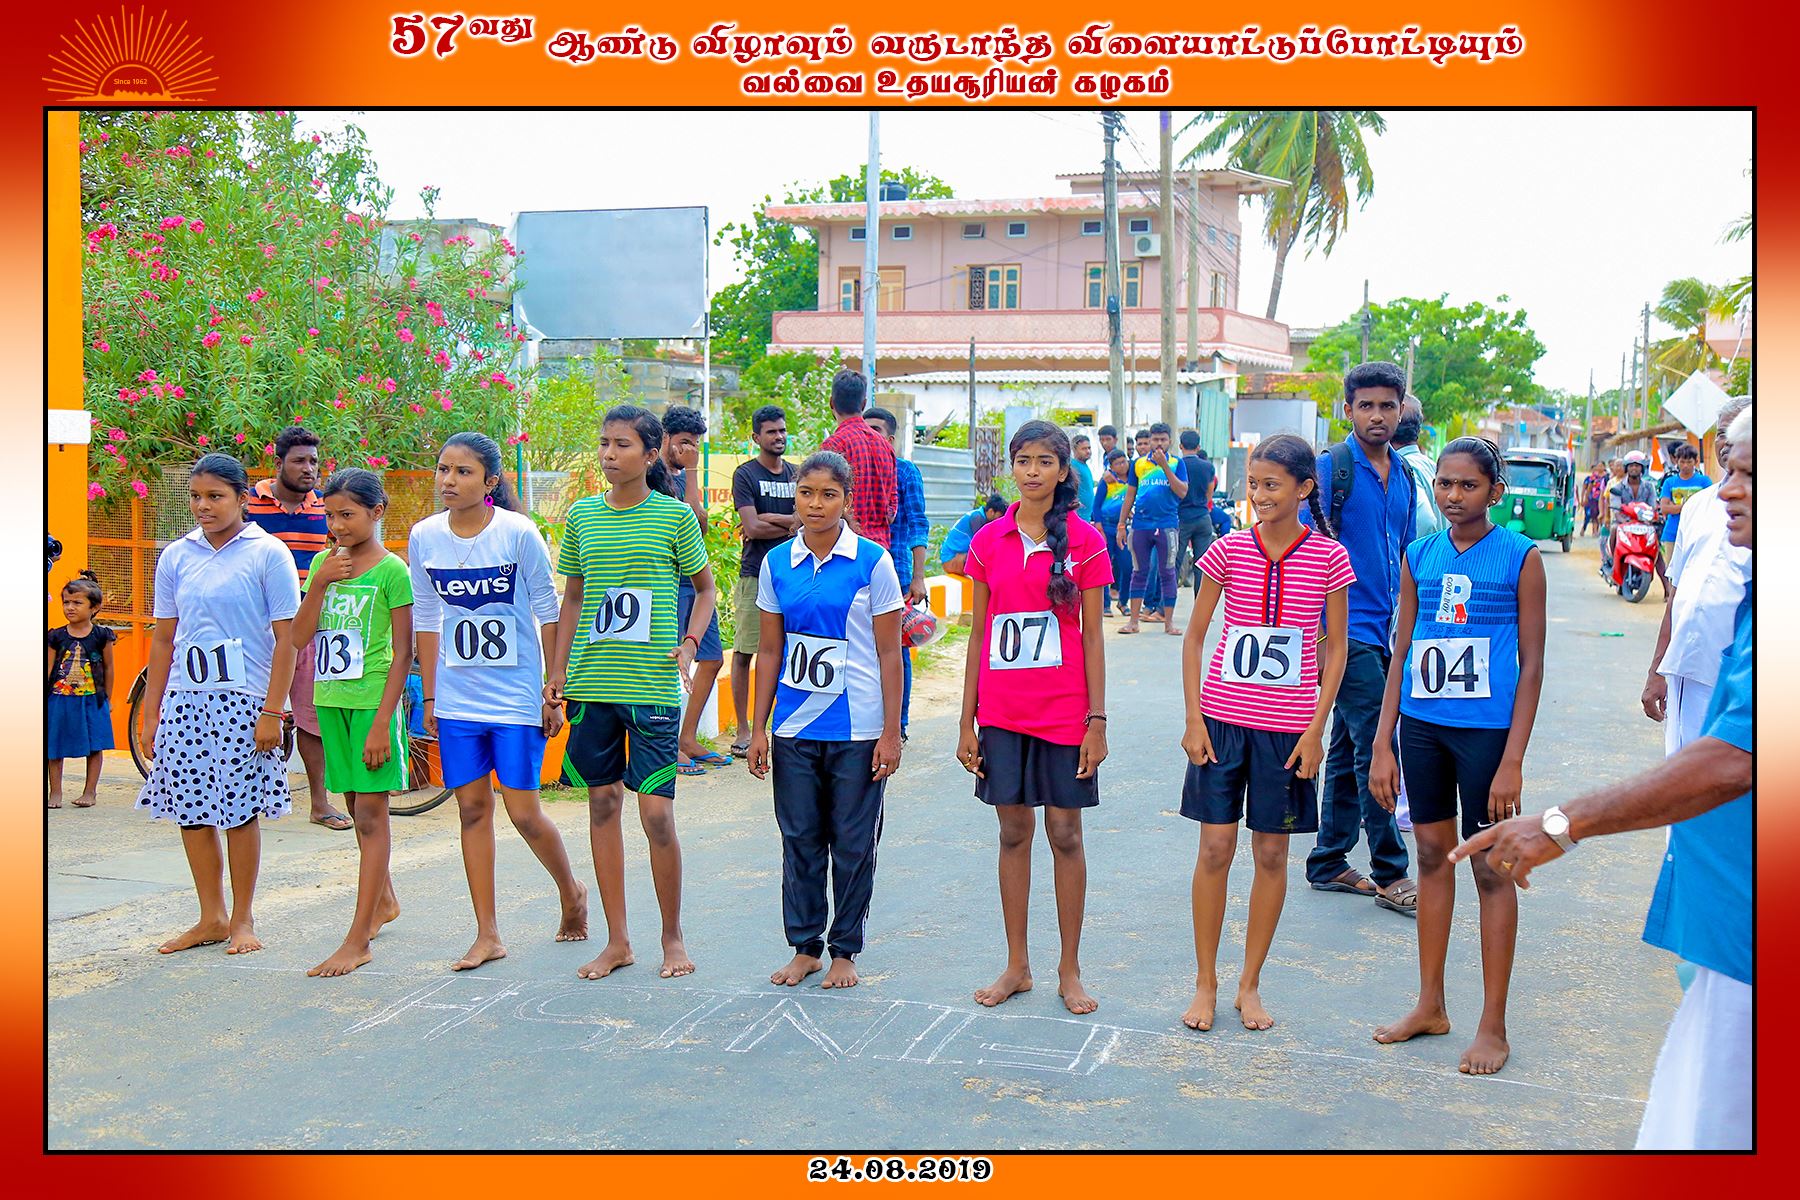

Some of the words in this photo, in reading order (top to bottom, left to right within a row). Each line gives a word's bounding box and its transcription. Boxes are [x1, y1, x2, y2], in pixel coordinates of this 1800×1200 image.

[1151, 478, 1170, 487] LANK
[322, 585, 370, 617] tay
[1444, 576, 1454, 595] COOL
[595, 592, 641, 634] 09
[317, 633, 352, 676] 03
[454, 619, 508, 661] 08
[999, 616, 1049, 663] 07
[1232, 633, 1291, 680] 05
[186, 643, 235, 684] 01
[790, 641, 838, 688] 06
[1420, 645, 1479, 694] 04
[342, 976, 1122, 1077] FINISH
